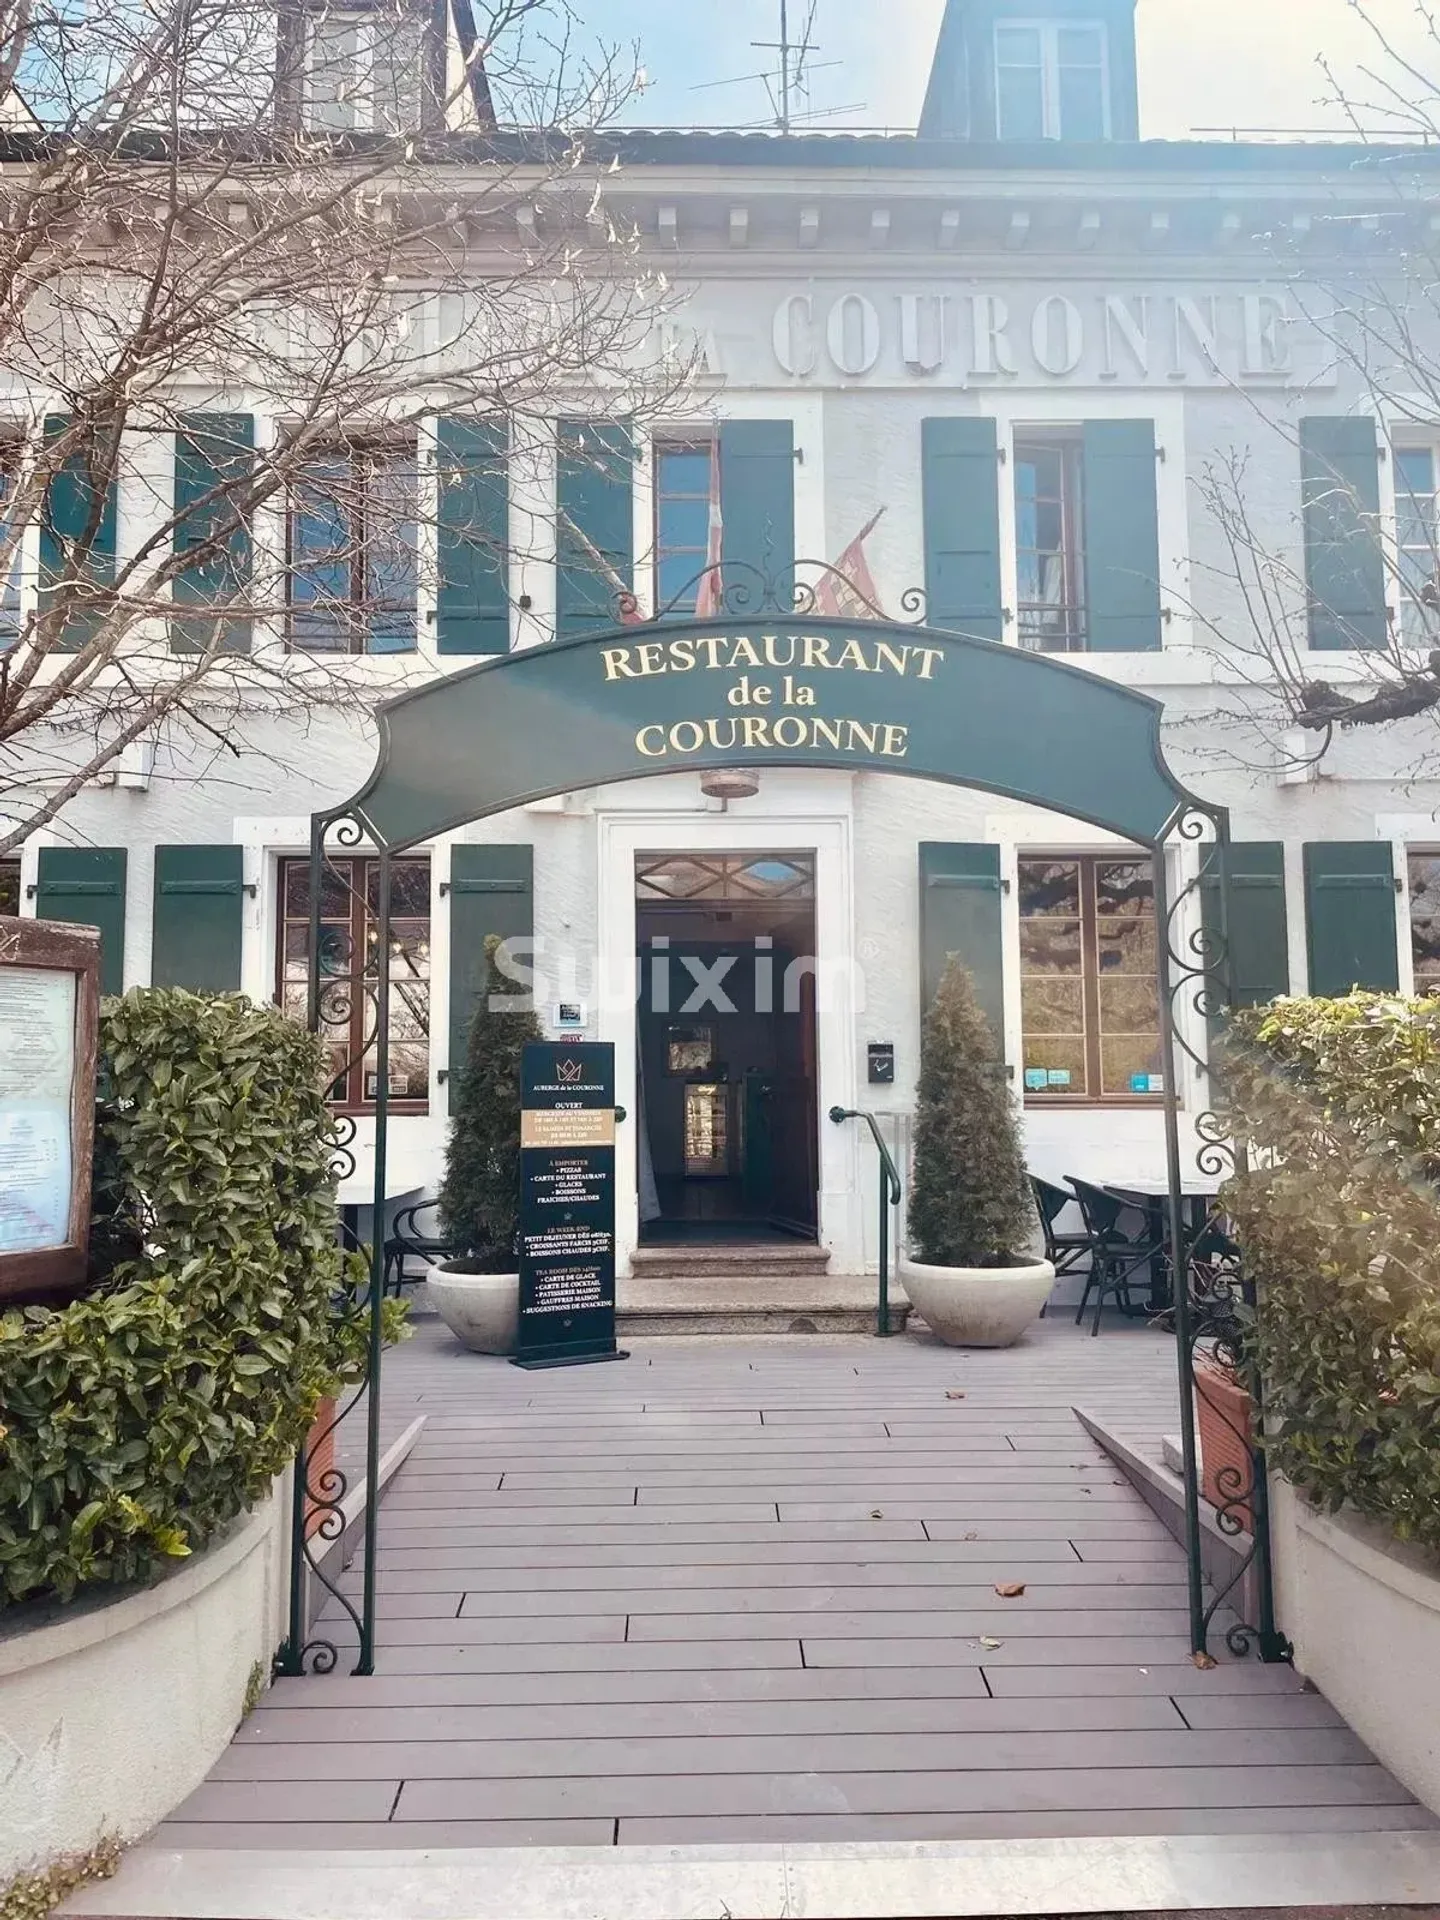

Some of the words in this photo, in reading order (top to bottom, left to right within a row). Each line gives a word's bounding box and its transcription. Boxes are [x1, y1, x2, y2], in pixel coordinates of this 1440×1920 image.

[772, 293, 1296, 378] COURONNE
[600, 636, 944, 681] RESTAURANT
[727, 676, 772, 706] de
[783, 675, 816, 706] la
[635, 717, 908, 757] COURONNE
[530, 1249, 561, 1257] BOISSONS
